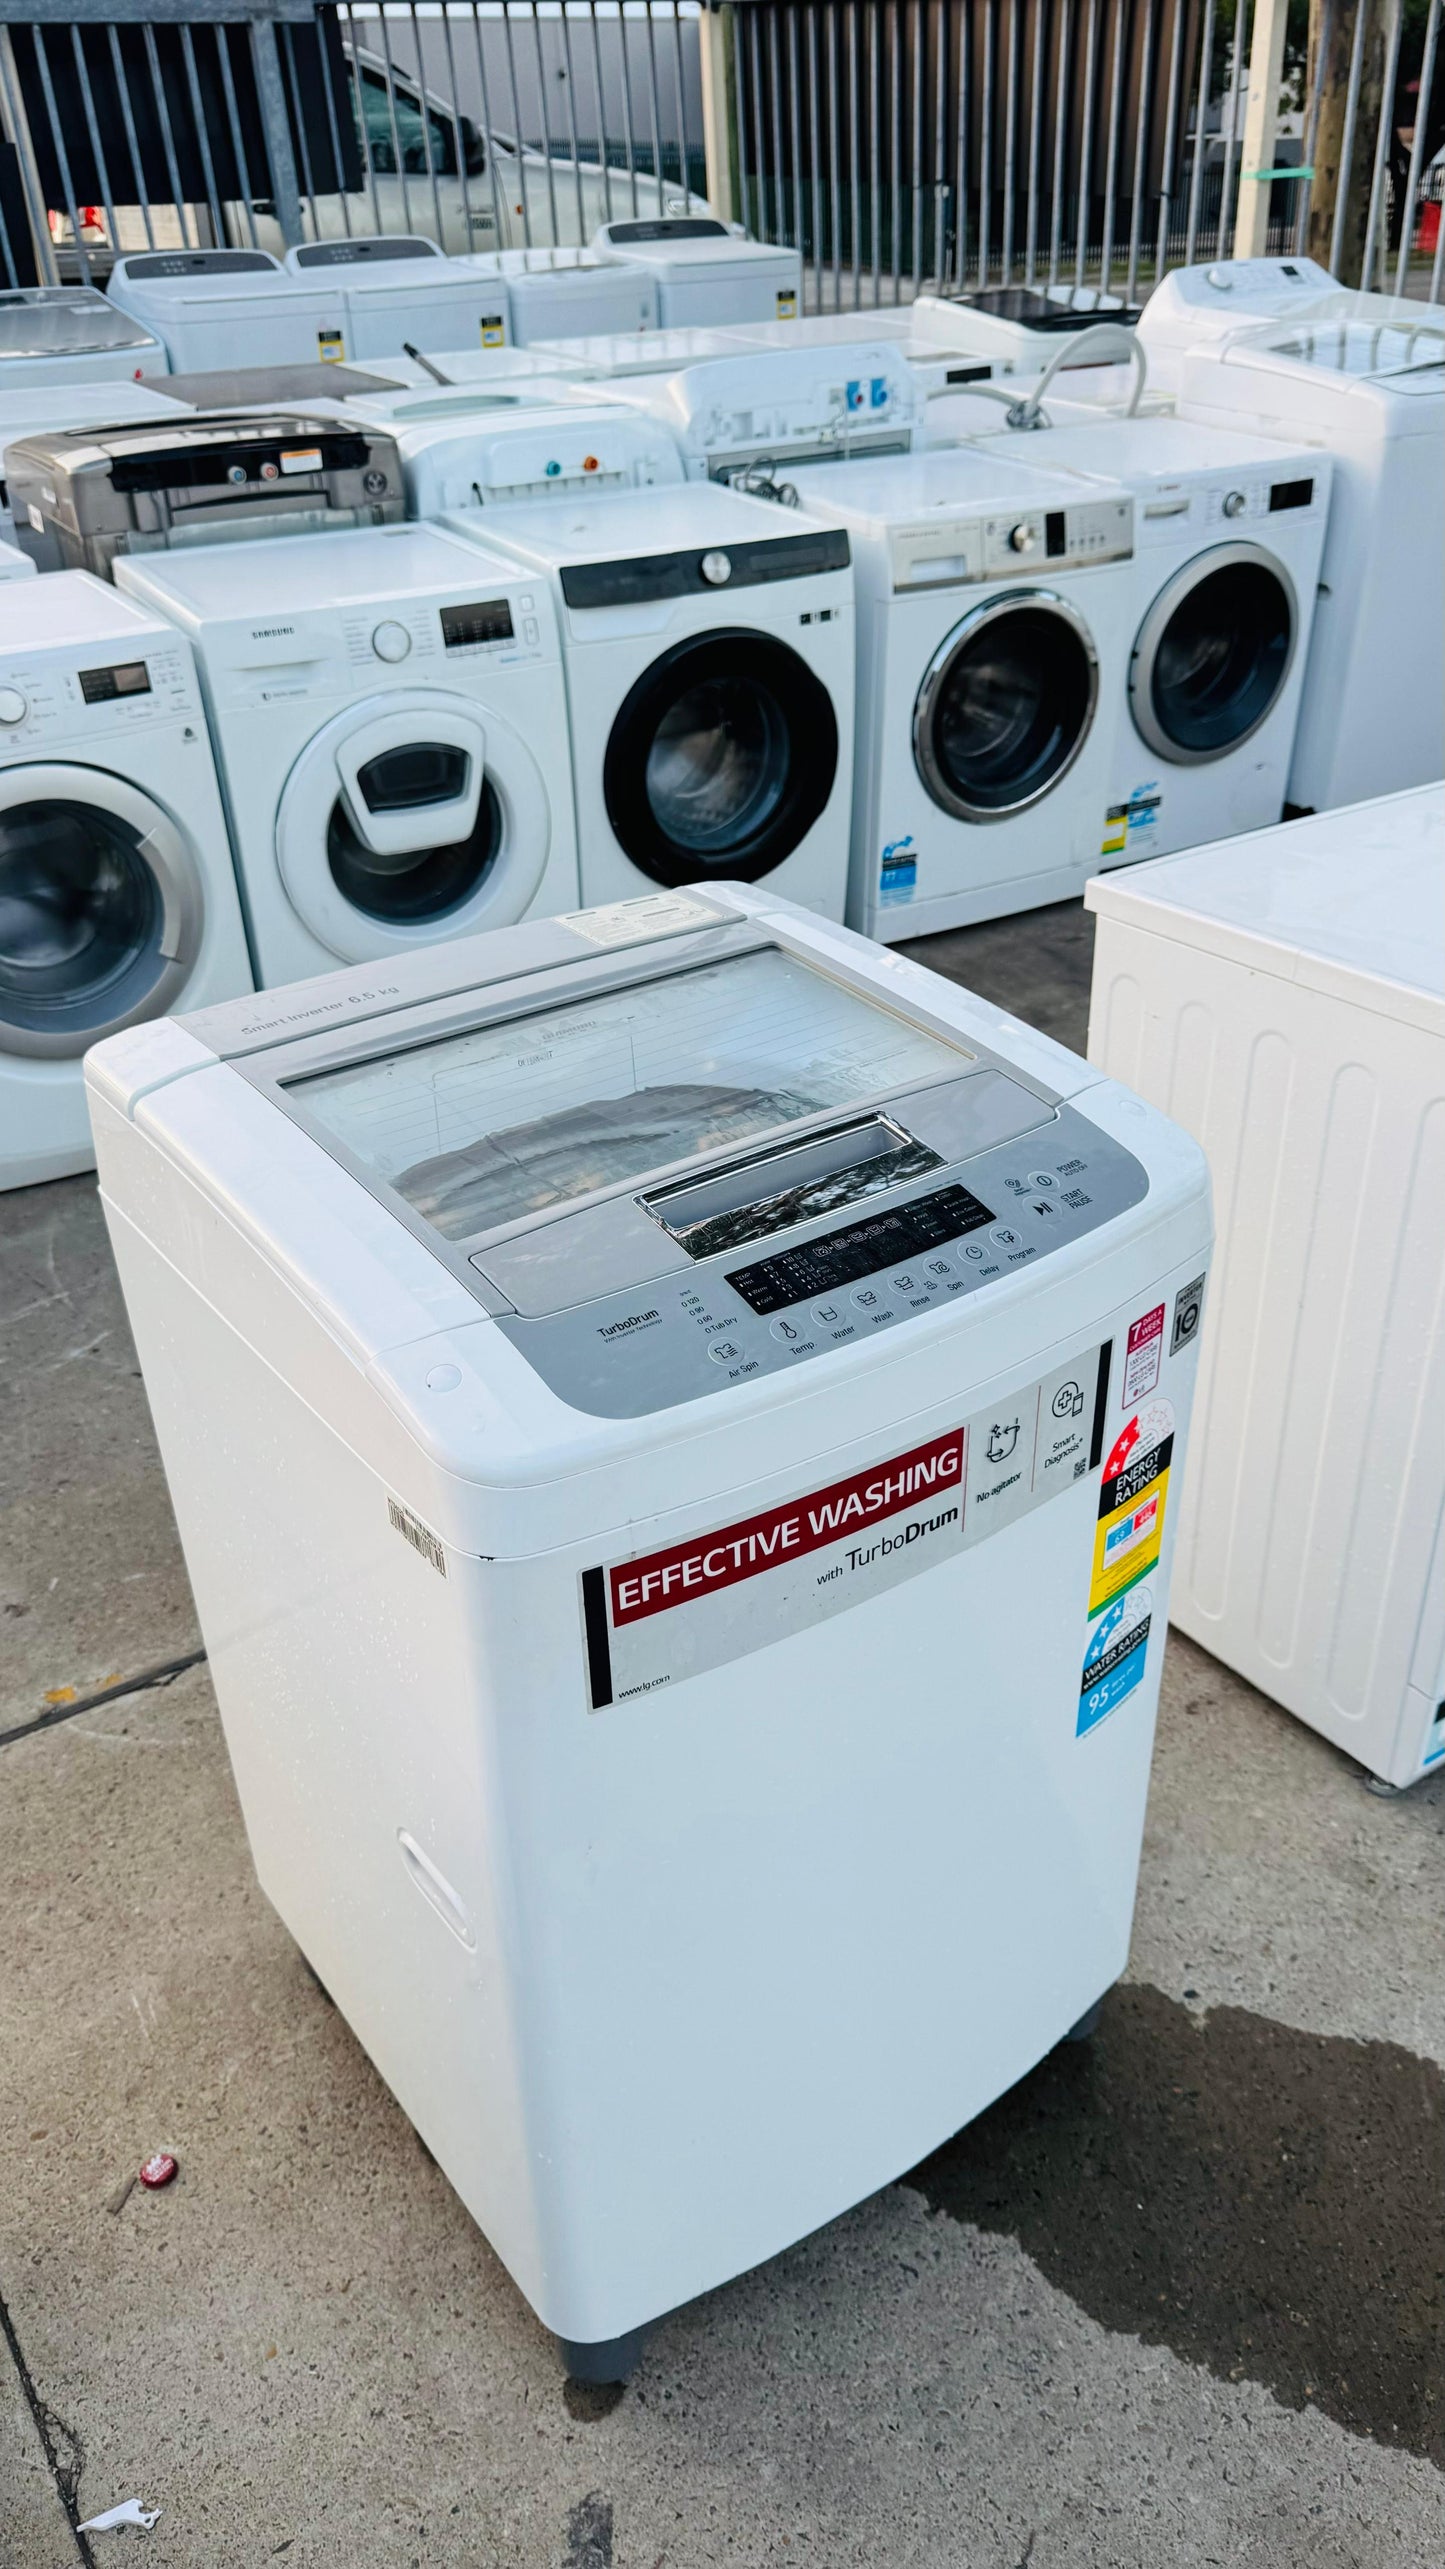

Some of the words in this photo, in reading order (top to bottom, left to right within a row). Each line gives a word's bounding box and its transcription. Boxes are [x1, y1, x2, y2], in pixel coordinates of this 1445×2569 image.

[251, 626, 295, 640] SAMSUNG
[241, 1018, 287, 1035] Smart
[286, 1001, 344, 1022] Inverter
[348, 992, 376, 1004] 6.5
[378, 986, 400, 996] kg
[1056, 1159, 1083, 1173] POWER
[1060, 1188, 1084, 1201] START
[1068, 1196, 1093, 1209] PAUSE
[1008, 1246, 1036, 1262] Program
[979, 1264, 1000, 1278] Delay
[947, 1279, 964, 1292] Spin
[687, 1296, 700, 1306] 120
[909, 1294, 931, 1308] Rinse
[597, 1308, 659, 1338] TurboDrum
[710, 1322, 725, 1332] Tub
[724, 1316, 738, 1328] Dry
[871, 1310, 894, 1324] Wash
[831, 1325, 855, 1340] Water
[1131, 1322, 1142, 1342] 7
[790, 1342, 817, 1356] Temp.
[728, 1368, 740, 1379] Air
[740, 1360, 759, 1374] Spin
[1052, 1433, 1076, 1452] Smart
[1116, 1448, 1161, 1490] ENERGY
[976, 1490, 991, 1503] No
[990, 1472, 1022, 1498] agitator
[1115, 1464, 1158, 1506] RATING
[618, 1517, 800, 1610] EFFECTIVE
[807, 1447, 959, 1535] WASHING
[816, 1564, 843, 1586] with
[845, 1506, 959, 1571] TurboDrum
[1085, 1650, 1118, 1679] WATER
[1117, 1619, 1150, 1654] RATING
[618, 1674, 670, 1699] www.lg.com
[1089, 1684, 1109, 1715] 95
